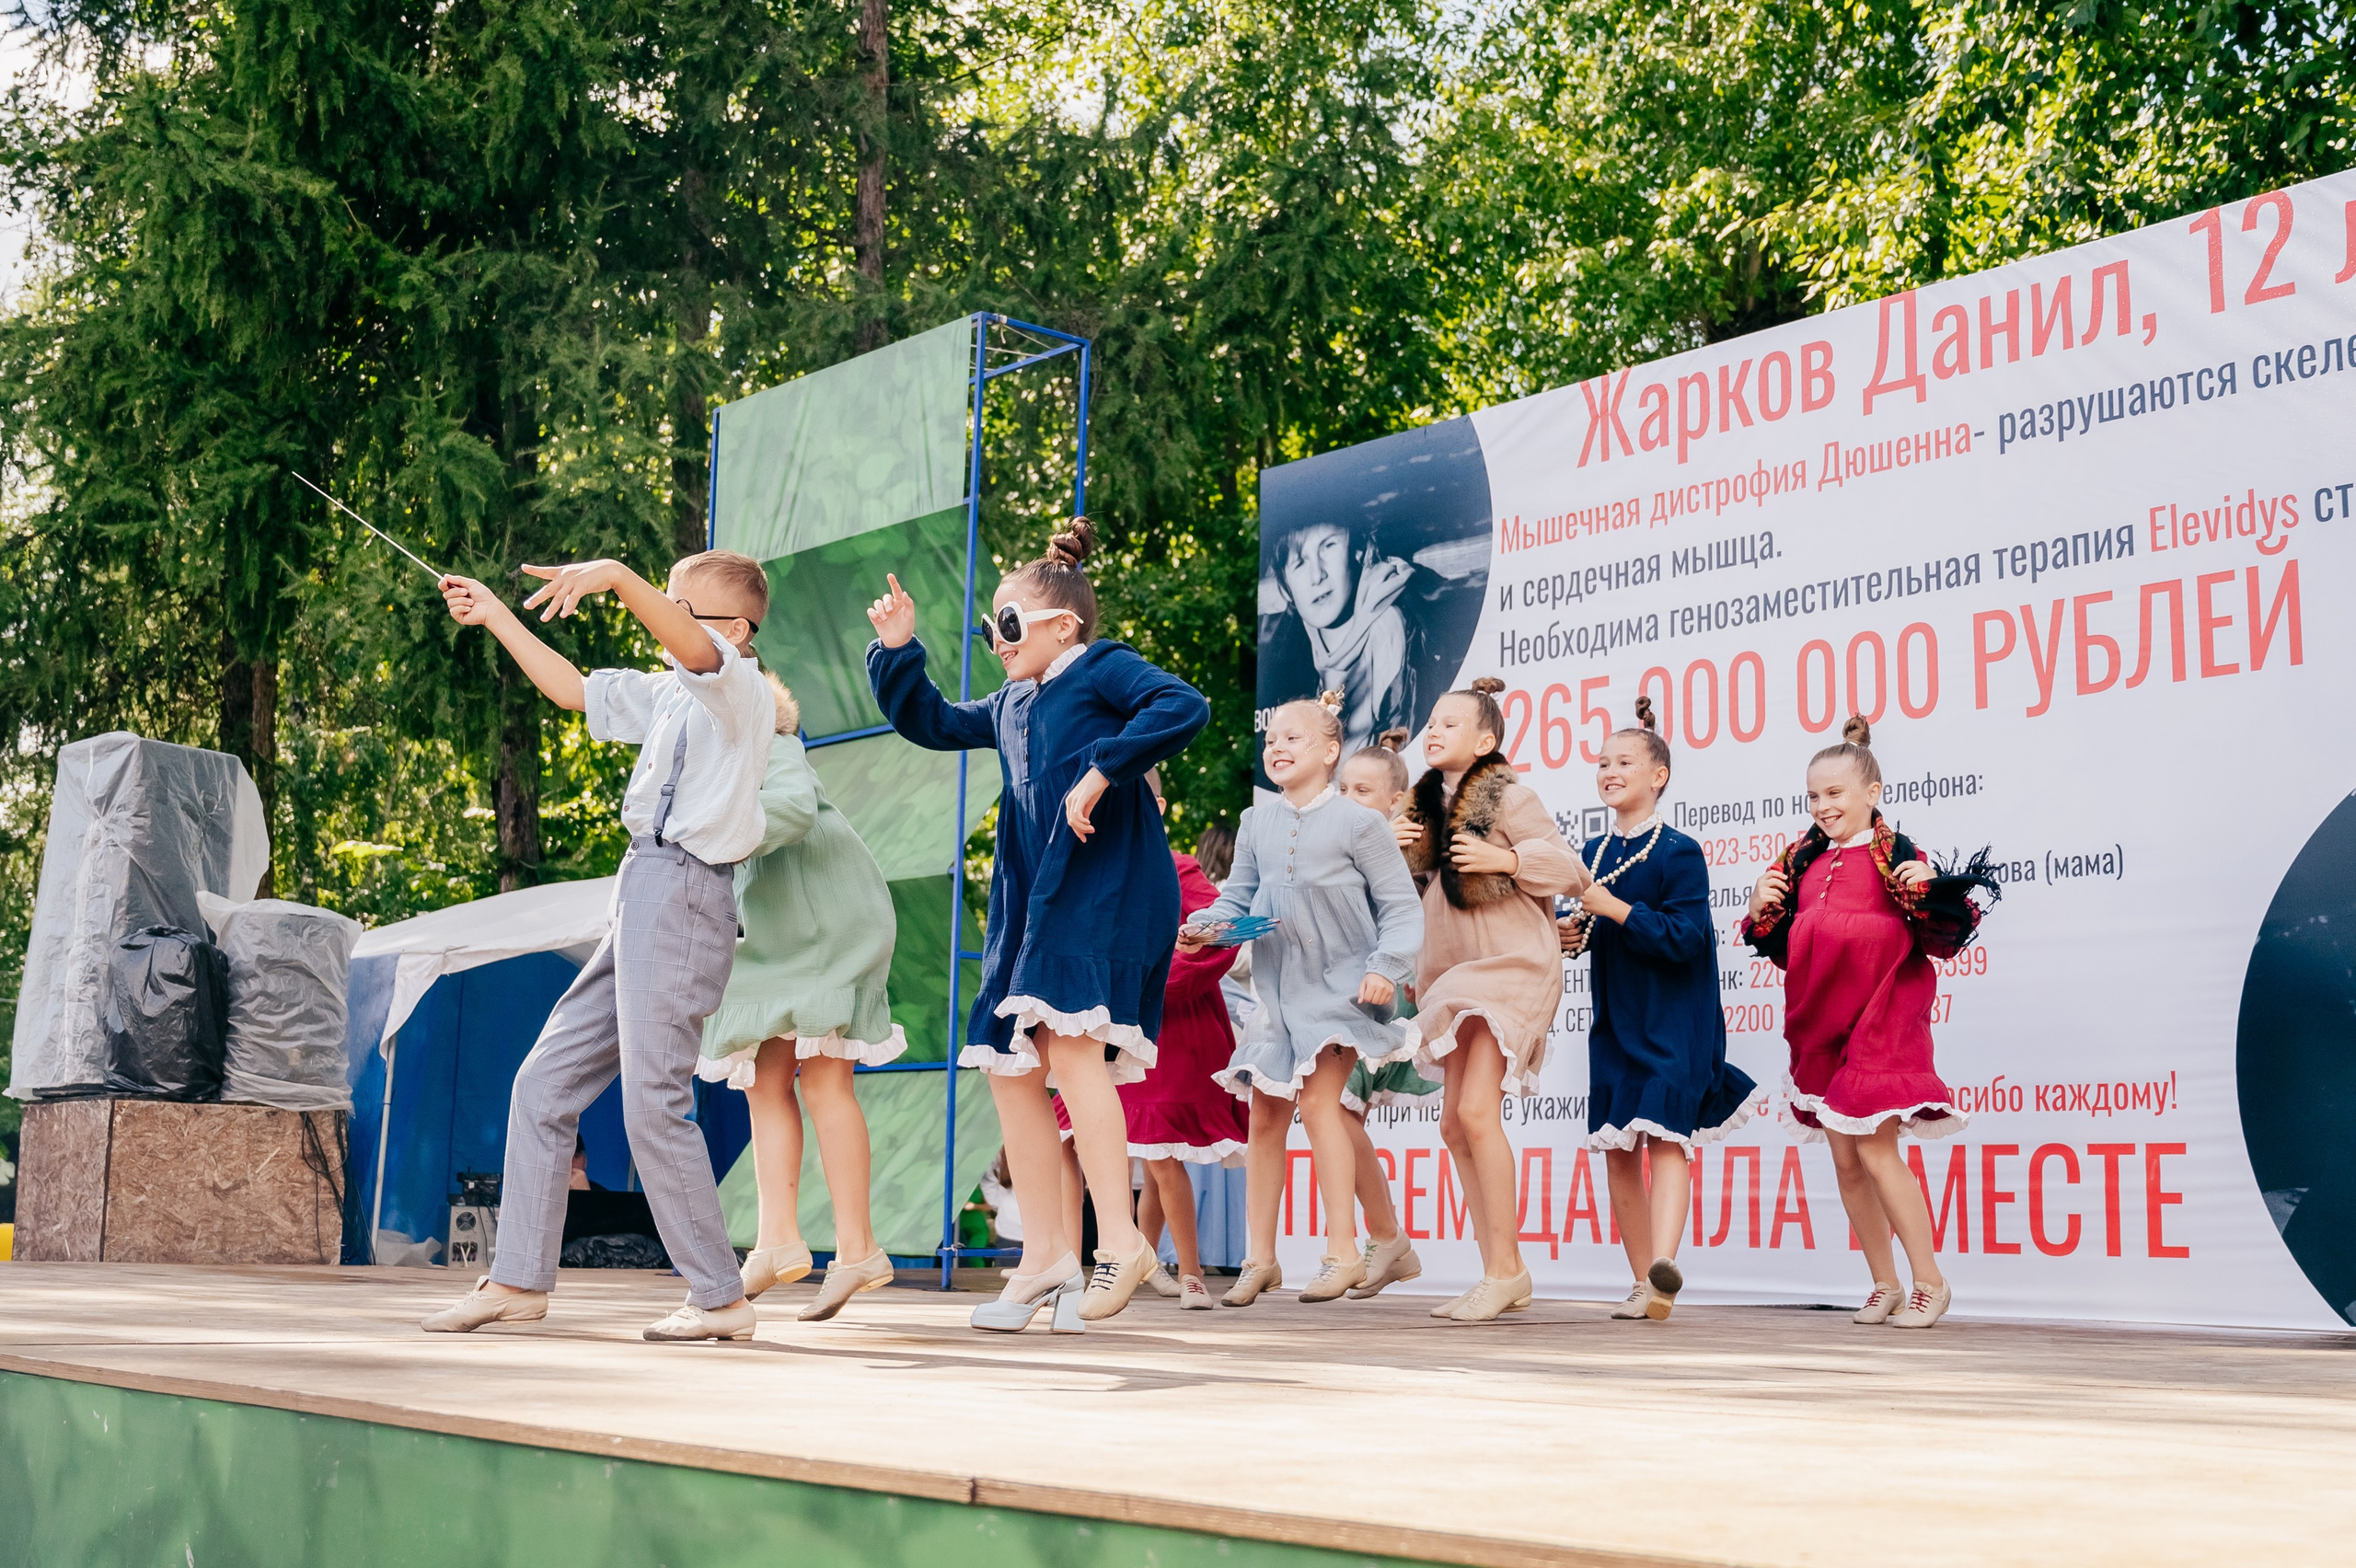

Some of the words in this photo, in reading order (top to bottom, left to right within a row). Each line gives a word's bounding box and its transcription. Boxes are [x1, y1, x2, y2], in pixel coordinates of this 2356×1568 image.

[1576, 340, 1836, 468] Жарков
[1863, 259, 2157, 416] Данил,
[2189, 190, 2296, 314] 12
[1501, 498, 1640, 555] Мышечная
[1649, 459, 1807, 529] дистрофия
[1818, 421, 1985, 492] Дюшенна-
[1998, 362, 2237, 455] разрушаются
[1500, 584, 1513, 612] и
[1523, 554, 1660, 611] сердечная
[1672, 530, 1783, 578] мышца.
[1500, 613, 1658, 668] Необходима
[1669, 552, 1981, 639] генозаместительная
[1992, 524, 2134, 583] терапия
[2149, 489, 2300, 552] Elevidys
[1502, 674, 1612, 774] 265
[1637, 651, 1766, 749] 000
[1796, 621, 1939, 733] 000
[1972, 535, 2304, 718] РУБЛЕЙ
[1674, 801, 1756, 832] Перевод
[1762, 797, 1784, 818] по
[1877, 771, 1984, 806] елефона:
[2045, 843, 2124, 886] (мама)
[1723, 1003, 1773, 1033] 2200
[1378, 1104, 1411, 1130] при
[1521, 1096, 1589, 1126] укажи
[2035, 1070, 2178, 1117] каждому!
[1849, 1142, 2190, 1259] МЕСТЕ
